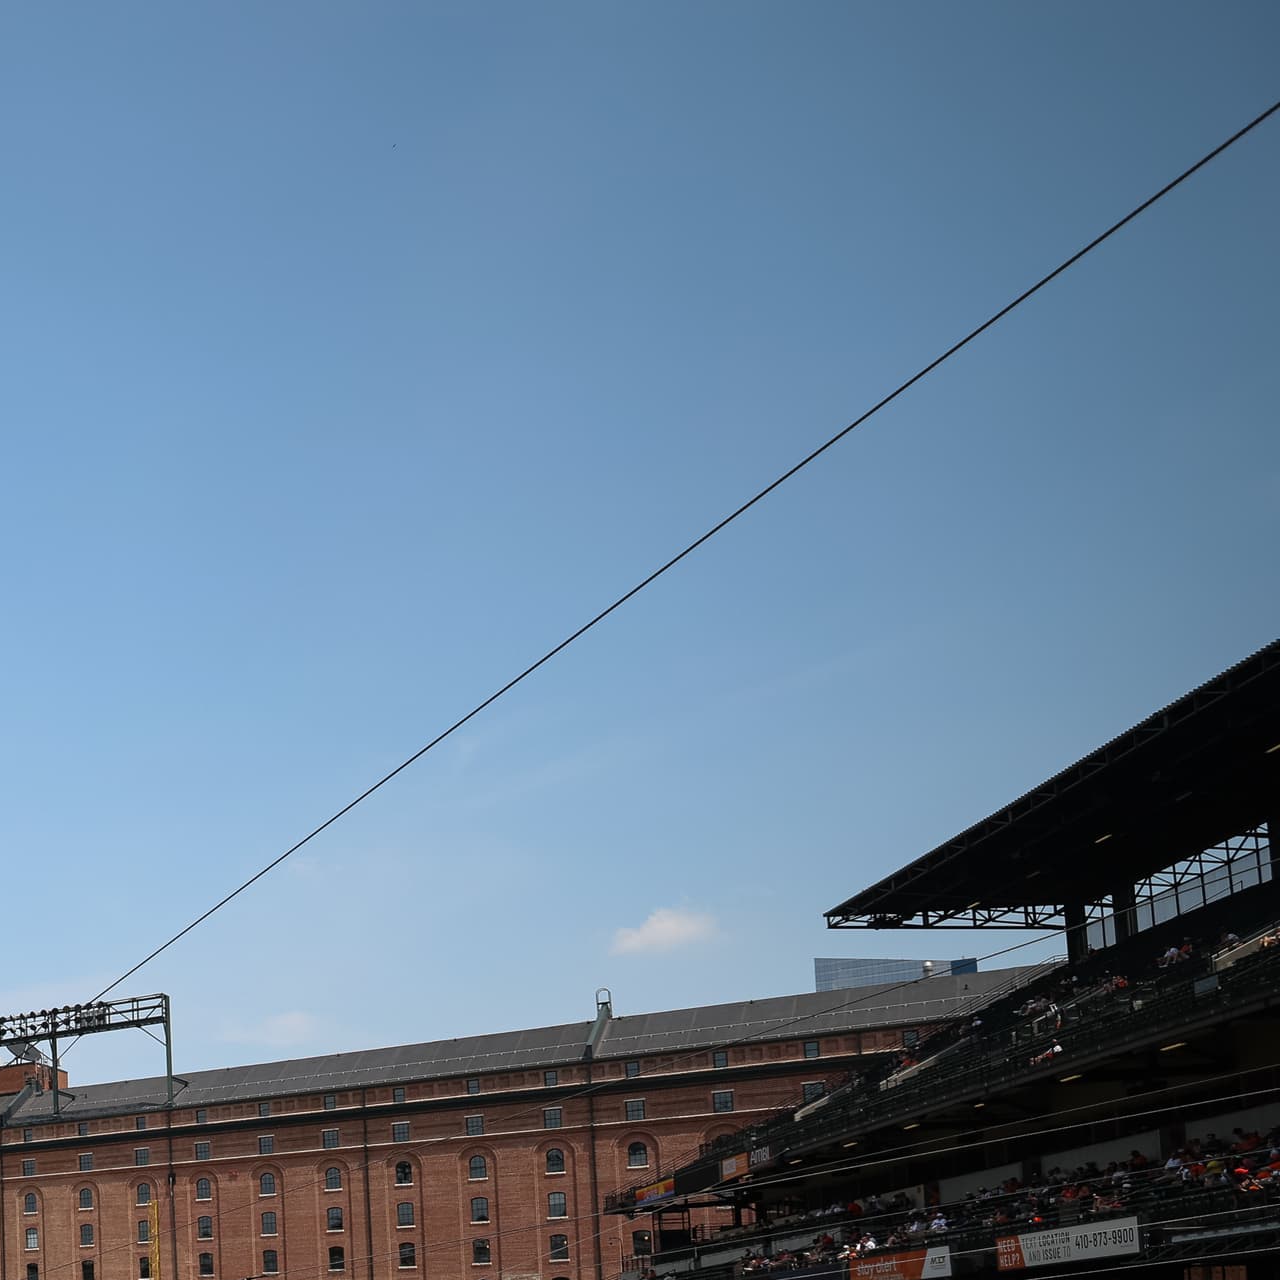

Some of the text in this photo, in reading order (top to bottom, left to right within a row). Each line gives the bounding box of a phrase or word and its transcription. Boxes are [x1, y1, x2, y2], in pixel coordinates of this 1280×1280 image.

[999, 1239, 1016, 1252] NEED
[1038, 1232, 1070, 1247] LOCATION
[1075, 1228, 1134, 1250] 410-873-9900
[1042, 1247, 1061, 1260] ISSUE
[1062, 1246, 1071, 1256] TO
[1000, 1254, 1021, 1267] HELP?
[856, 1262, 874, 1279] stay
